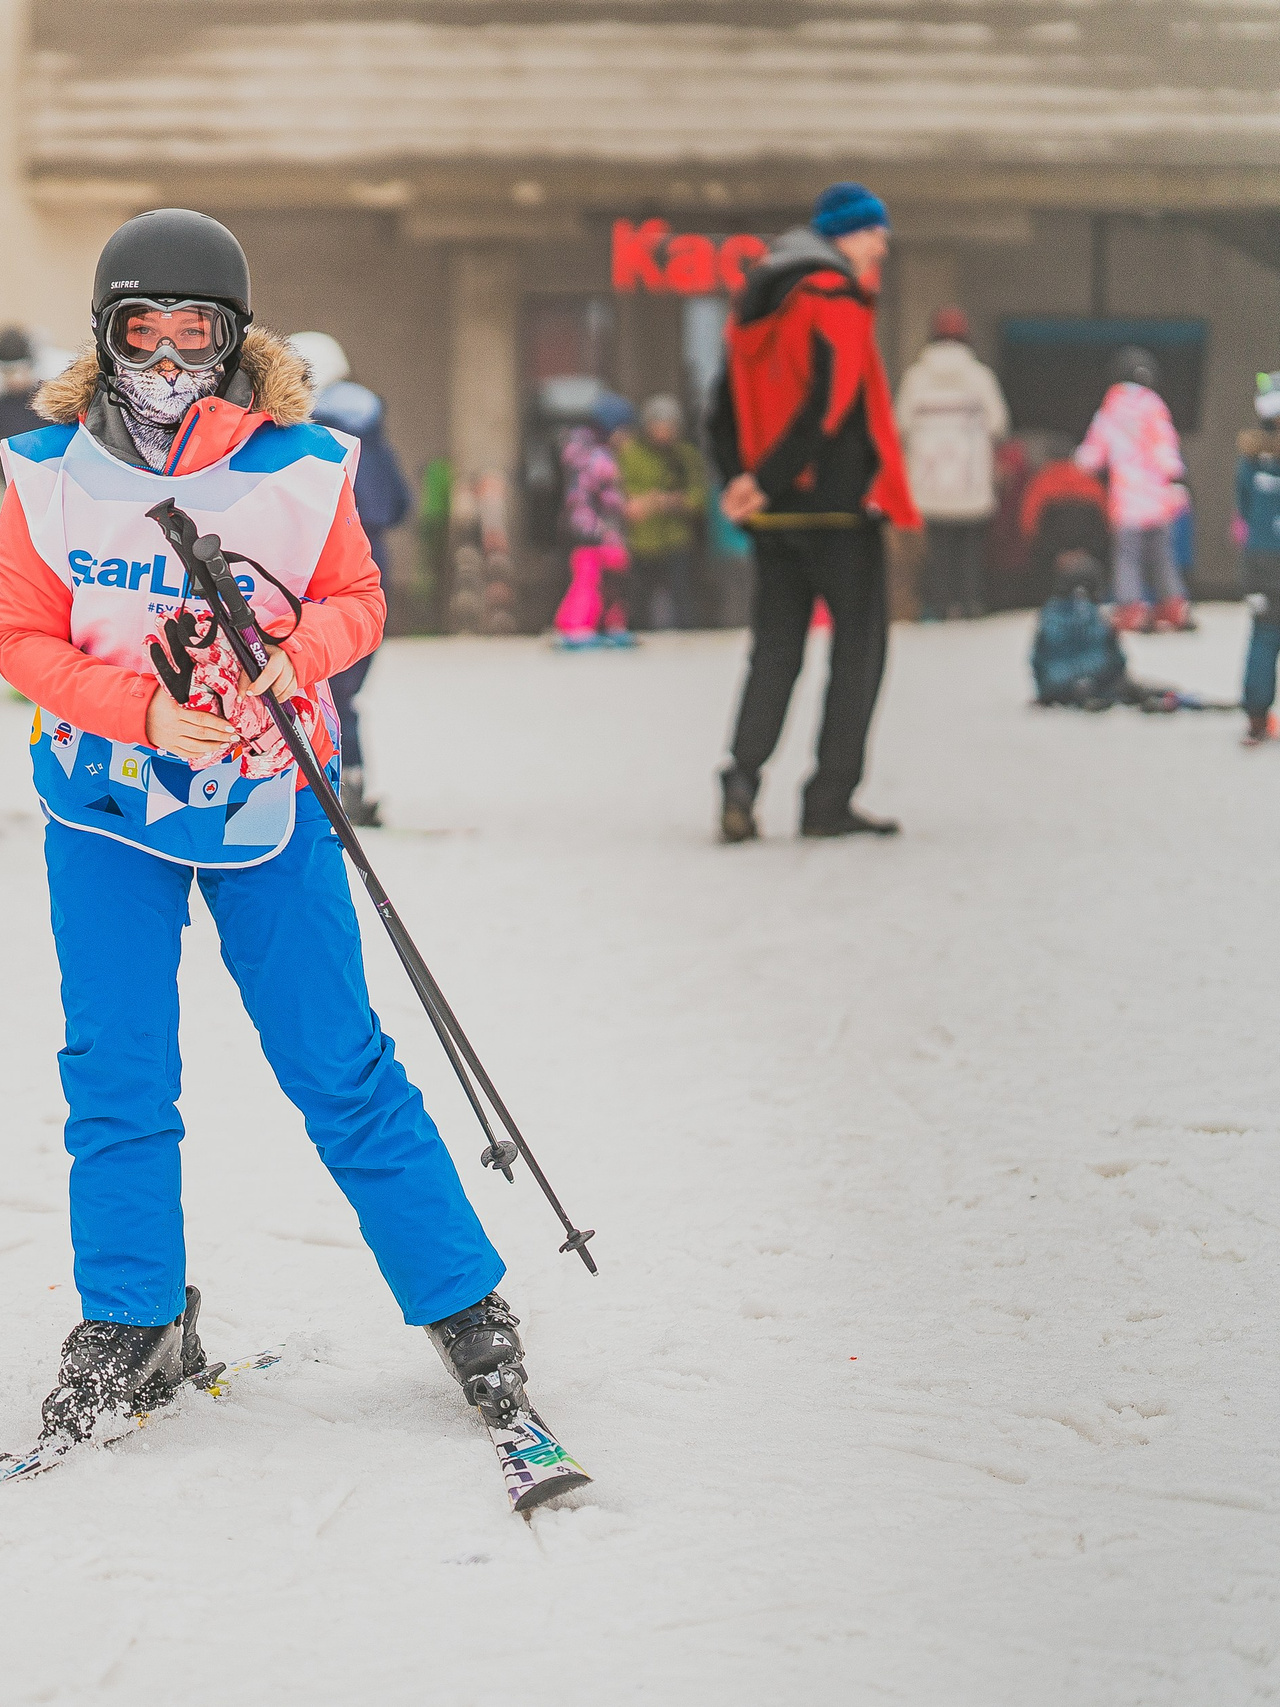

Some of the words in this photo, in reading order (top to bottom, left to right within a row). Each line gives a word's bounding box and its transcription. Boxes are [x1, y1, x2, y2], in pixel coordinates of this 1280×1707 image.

[612, 217, 769, 294] Кас
[110, 280, 140, 290] SKIFREE
[68, 549, 256, 602] StarLe
